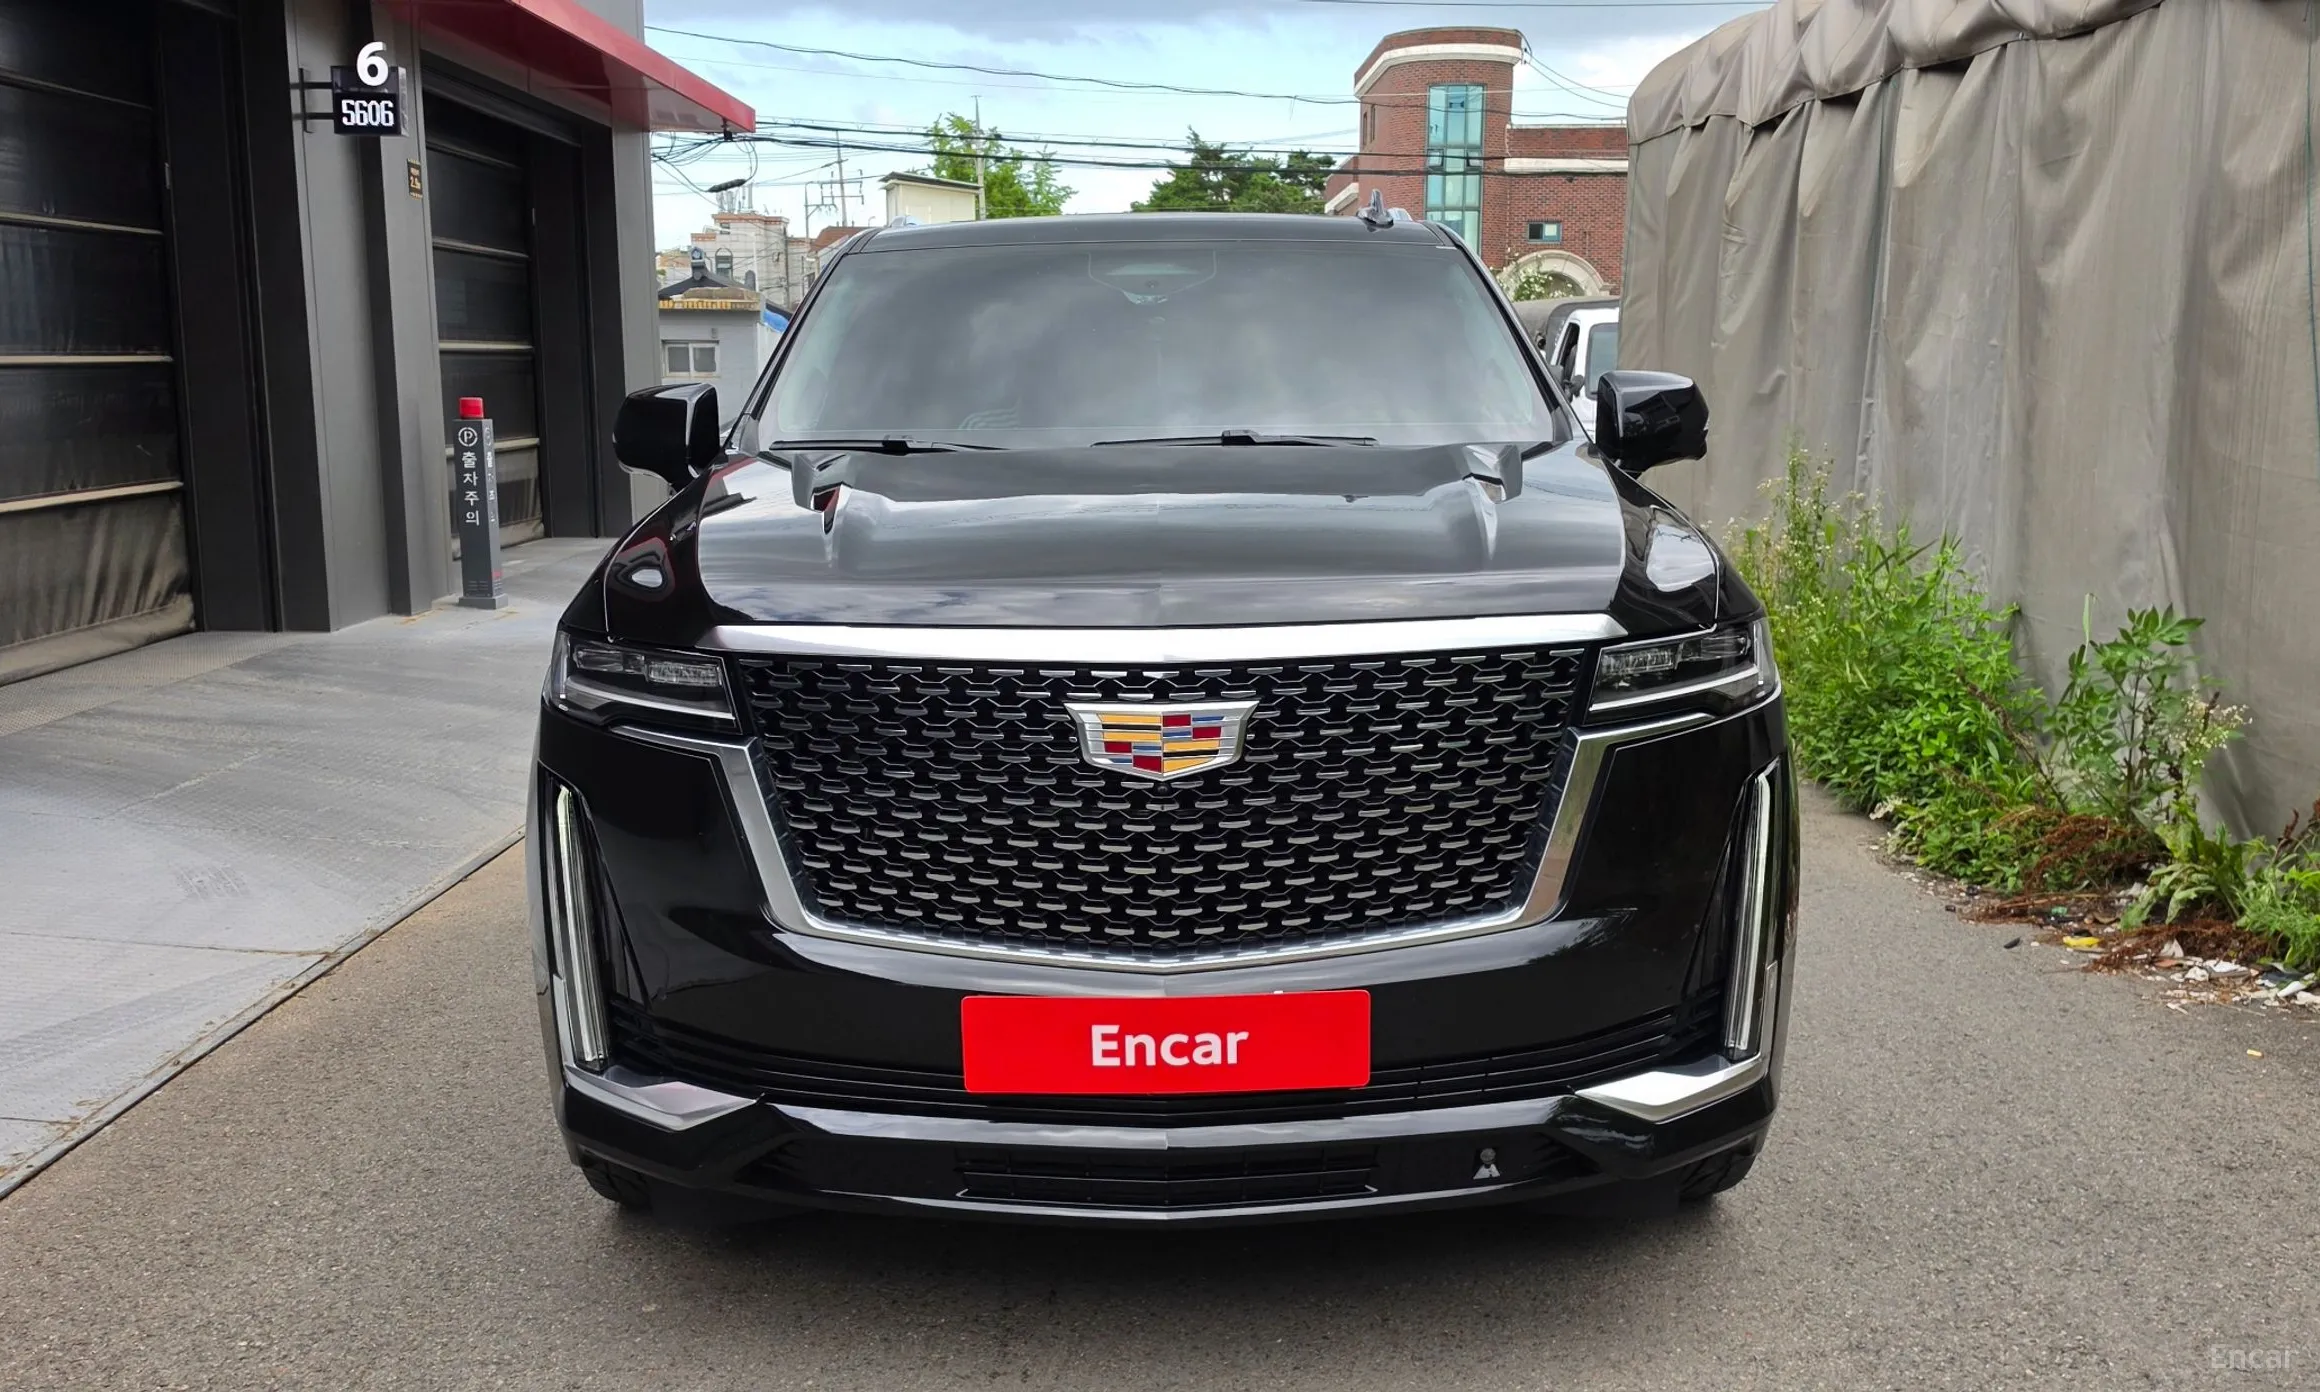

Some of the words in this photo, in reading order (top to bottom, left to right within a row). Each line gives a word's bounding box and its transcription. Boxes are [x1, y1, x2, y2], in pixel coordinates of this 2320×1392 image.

[356, 41, 388, 87] 6
[341, 99, 395, 127] 5606
[1091, 1024, 1249, 1067] Encar
